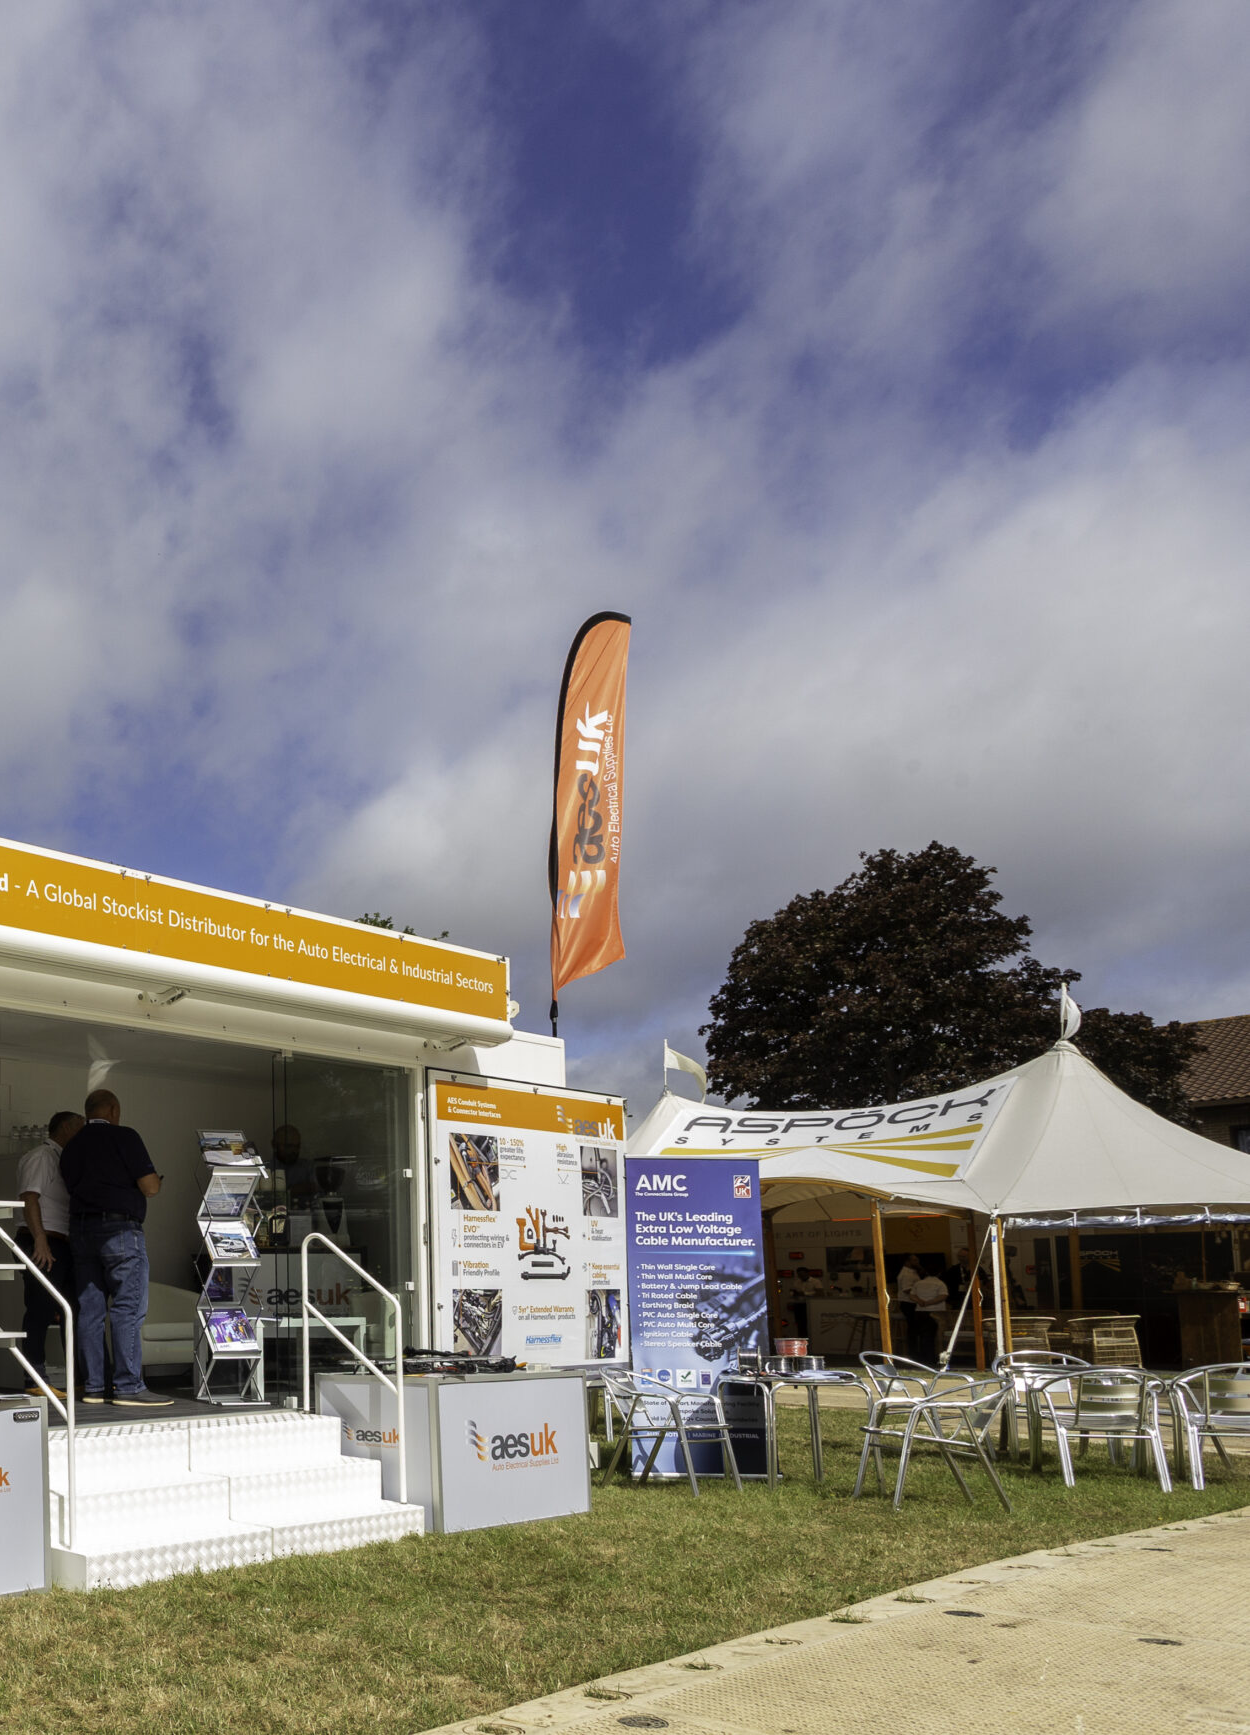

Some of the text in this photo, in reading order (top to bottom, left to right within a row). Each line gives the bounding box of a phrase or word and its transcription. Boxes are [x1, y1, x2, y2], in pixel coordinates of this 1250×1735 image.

[603, 736, 618, 781] Supplies
[606, 782, 620, 833] Electrical
[26, 880, 40, 898] A
[44, 884, 97, 911] Global
[102, 896, 163, 925] Stockist
[169, 911, 245, 942] Distributor
[249, 927, 269, 947] for
[273, 933, 294, 952] the
[298, 938, 328, 959] Auto
[332, 946, 386, 972] Electrical
[389, 959, 398, 974] &
[402, 960, 453, 985] Industrial
[456, 971, 493, 994] Sectors
[683, 1088, 997, 1134] ASPÖCK
[575, 1118, 616, 1141] aesuk
[675, 1113, 983, 1146] SYSTEMS
[636, 1174, 687, 1191] AMC
[635, 1212, 656, 1221] The
[686, 1212, 733, 1224] Leading
[636, 1224, 741, 1236] Extra Low Voltage
[636, 1236, 755, 1246] Cable Manufacturer.
[491, 1423, 558, 1461] aesuk
[492, 1463, 505, 1472] Auto
[506, 1460, 527, 1470] Electrical
[529, 1459, 550, 1469] Supplies
